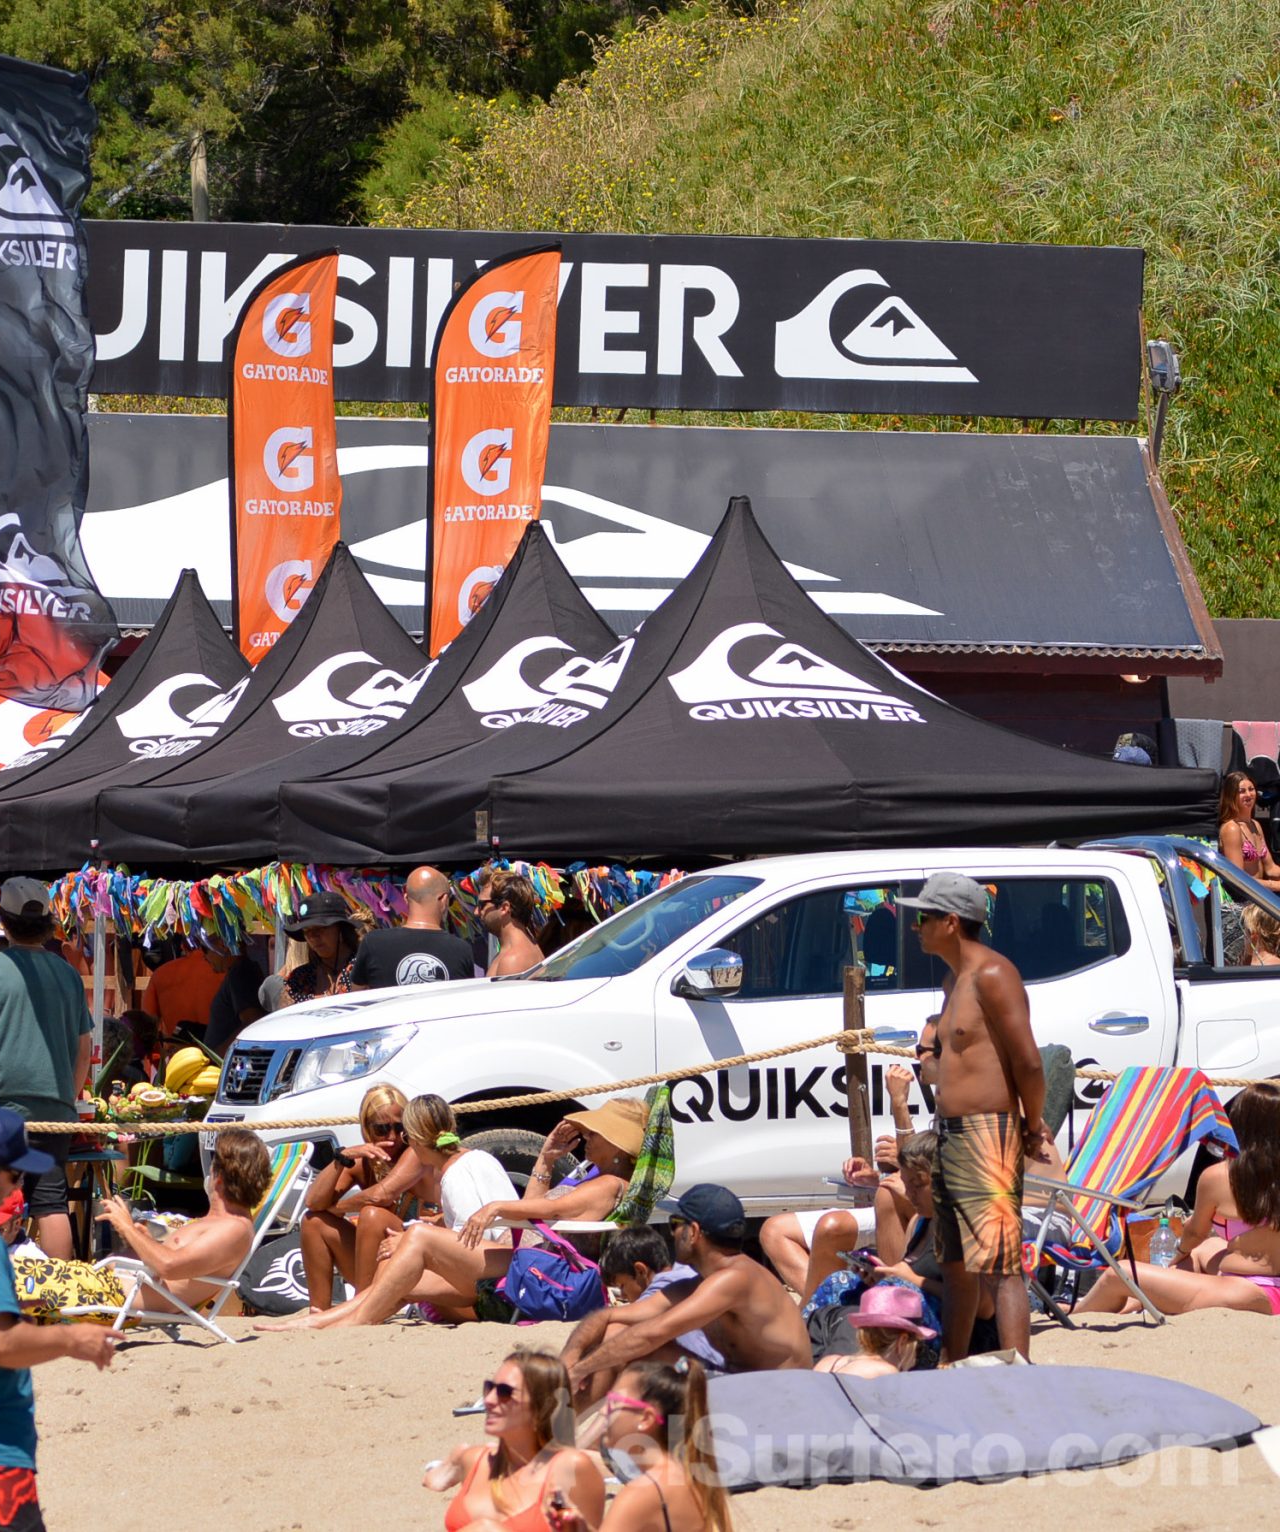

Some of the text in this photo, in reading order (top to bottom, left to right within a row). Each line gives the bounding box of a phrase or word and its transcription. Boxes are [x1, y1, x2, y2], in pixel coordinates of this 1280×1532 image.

[242, 362, 329, 385] GATORADE
[445, 366, 544, 385] GATORADE
[245, 499, 335, 518] GATORADE
[688, 700, 928, 723] QUIKSILVER
